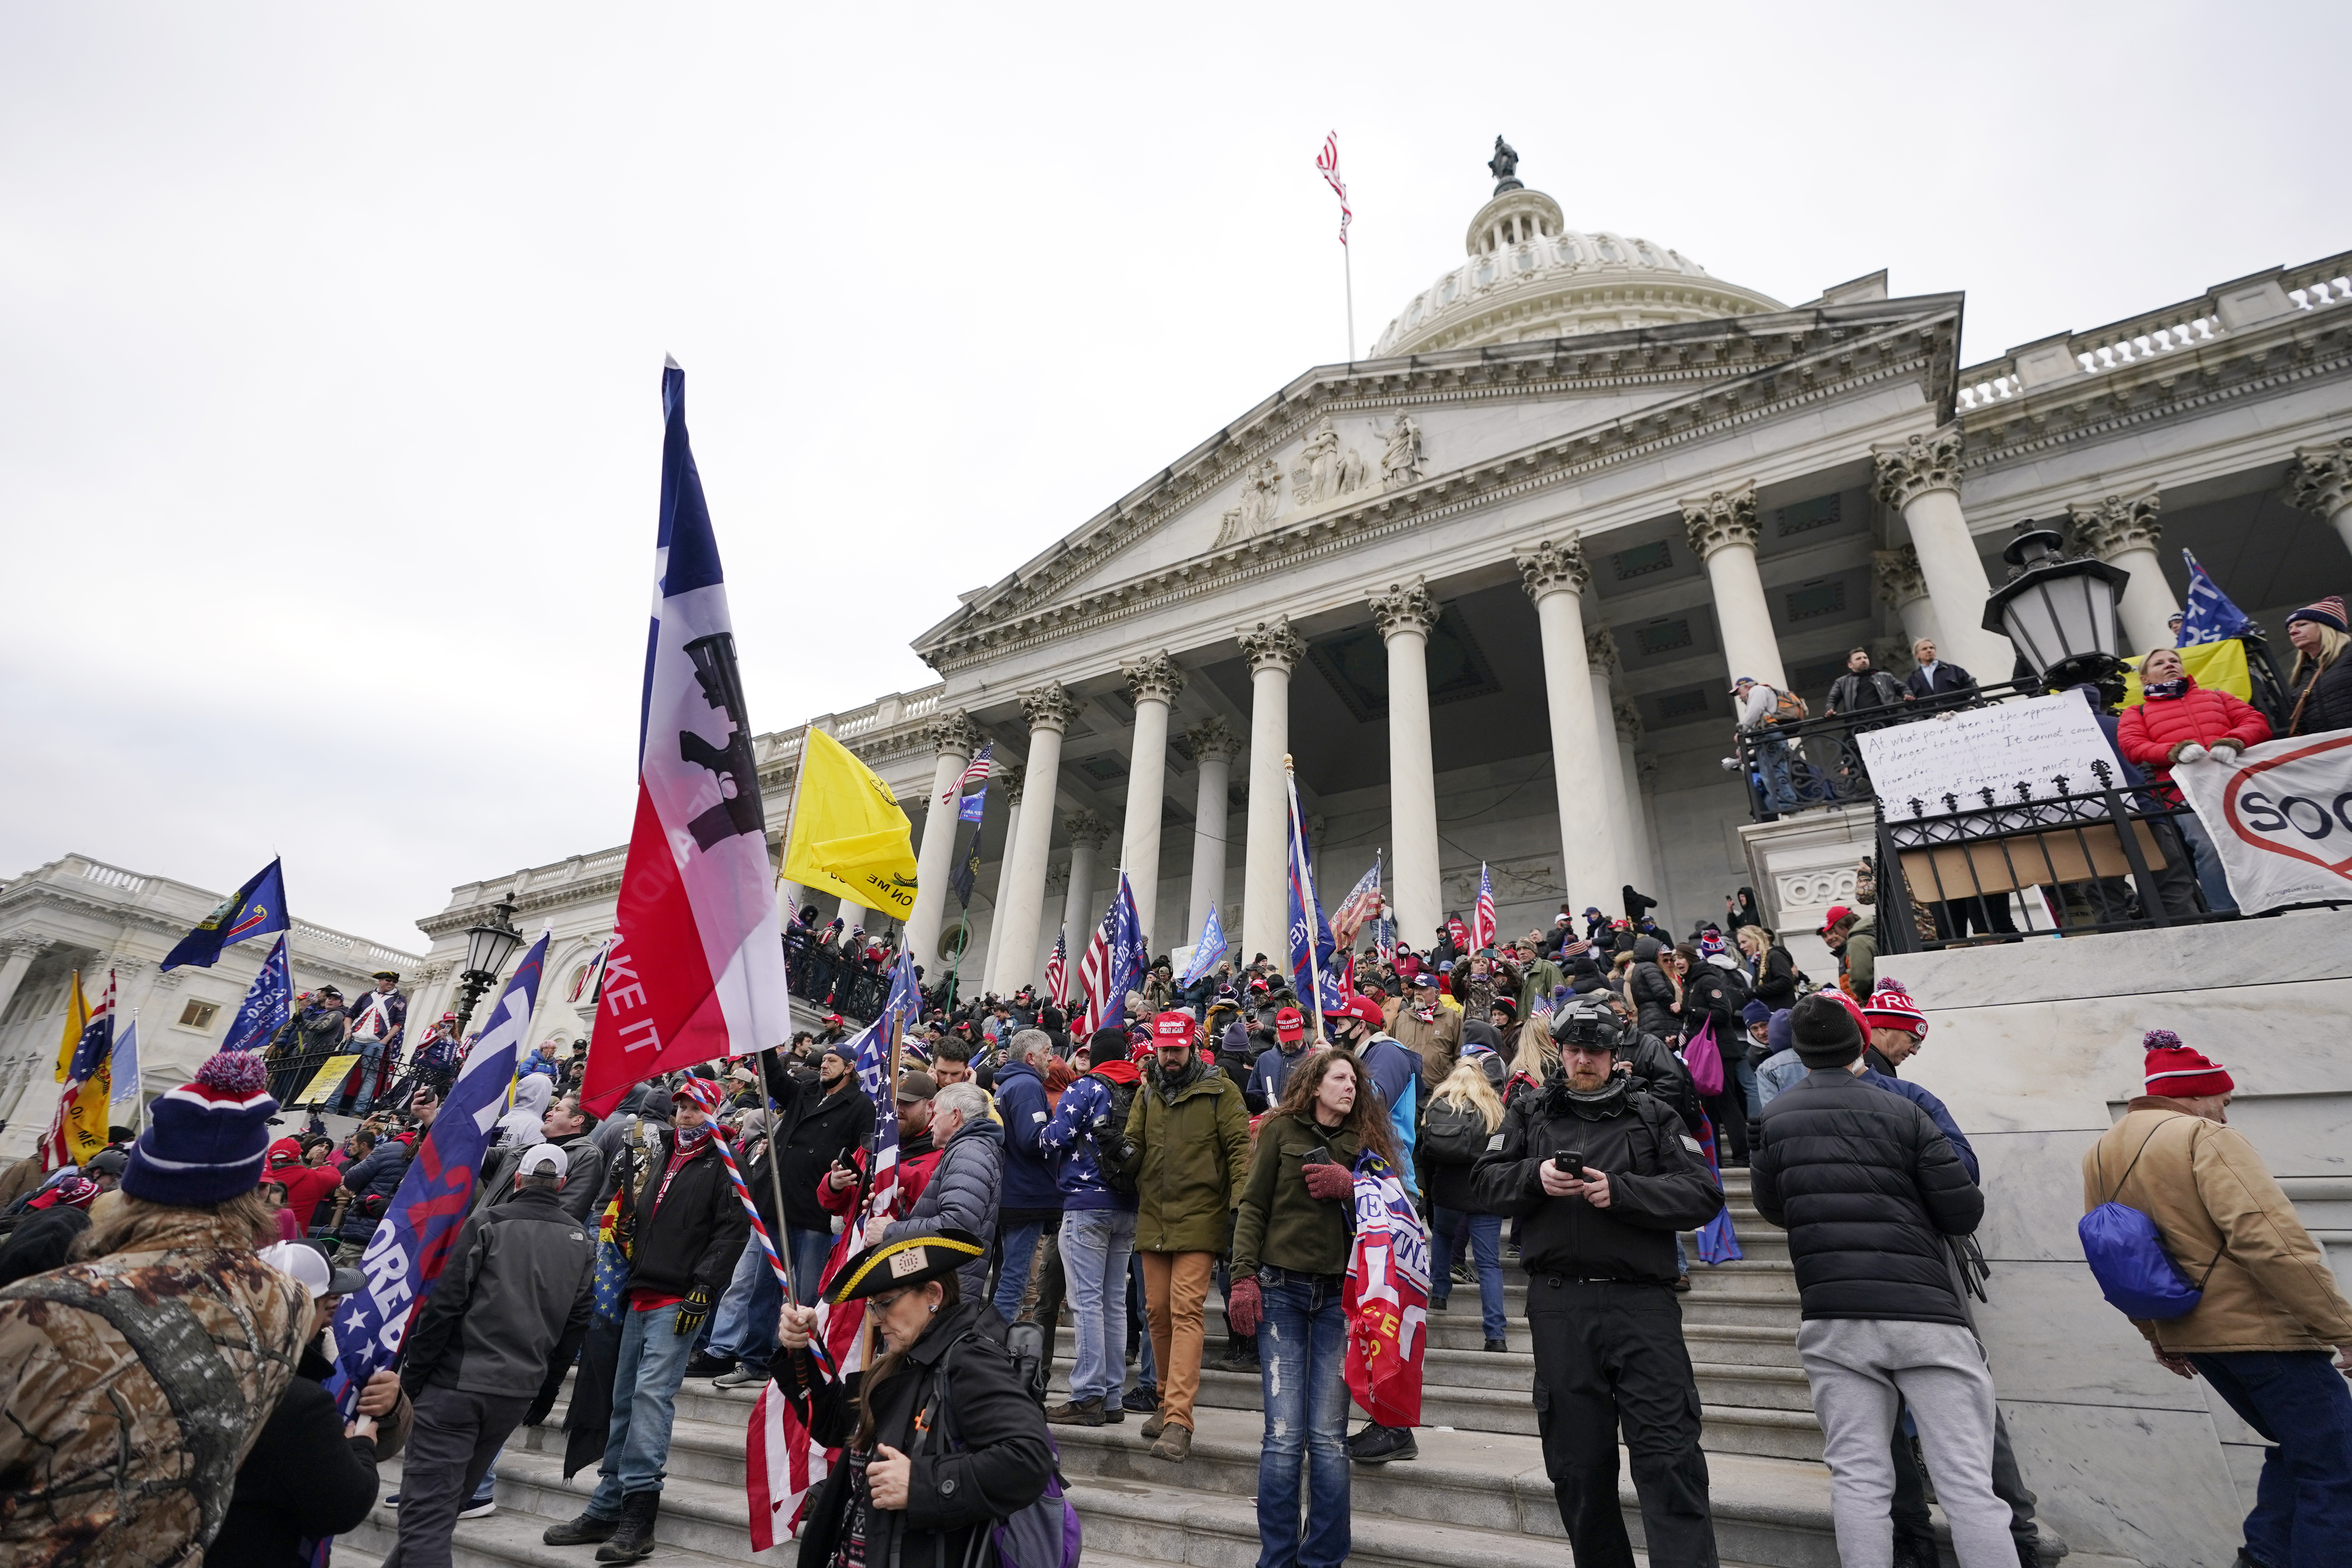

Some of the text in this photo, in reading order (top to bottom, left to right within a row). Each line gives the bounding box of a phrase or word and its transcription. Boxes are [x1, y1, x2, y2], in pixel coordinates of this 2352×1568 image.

[1869, 738, 1887, 753] At
[1891, 730, 1920, 746] what
[1924, 725, 1951, 744] point
[1956, 721, 1982, 732] then
[1999, 712, 2019, 720] the
[2023, 701, 2069, 720] approach
[2004, 735, 2022, 747] It
[2028, 727, 2065, 741] cannot
[1874, 753, 1886, 766] of
[1891, 748, 1929, 762] danger
[1964, 724, 2011, 742] expected?
[1882, 775, 1903, 787] from
[1918, 786, 1947, 798] nation
[1953, 778, 1963, 788] of
[2018, 767, 2036, 777] we
[2042, 757, 2071, 772] must
[1892, 799, 1936, 816] thrgh
[604, 915, 662, 1053] AKE IT
[77, 1130, 96, 1149] ME
